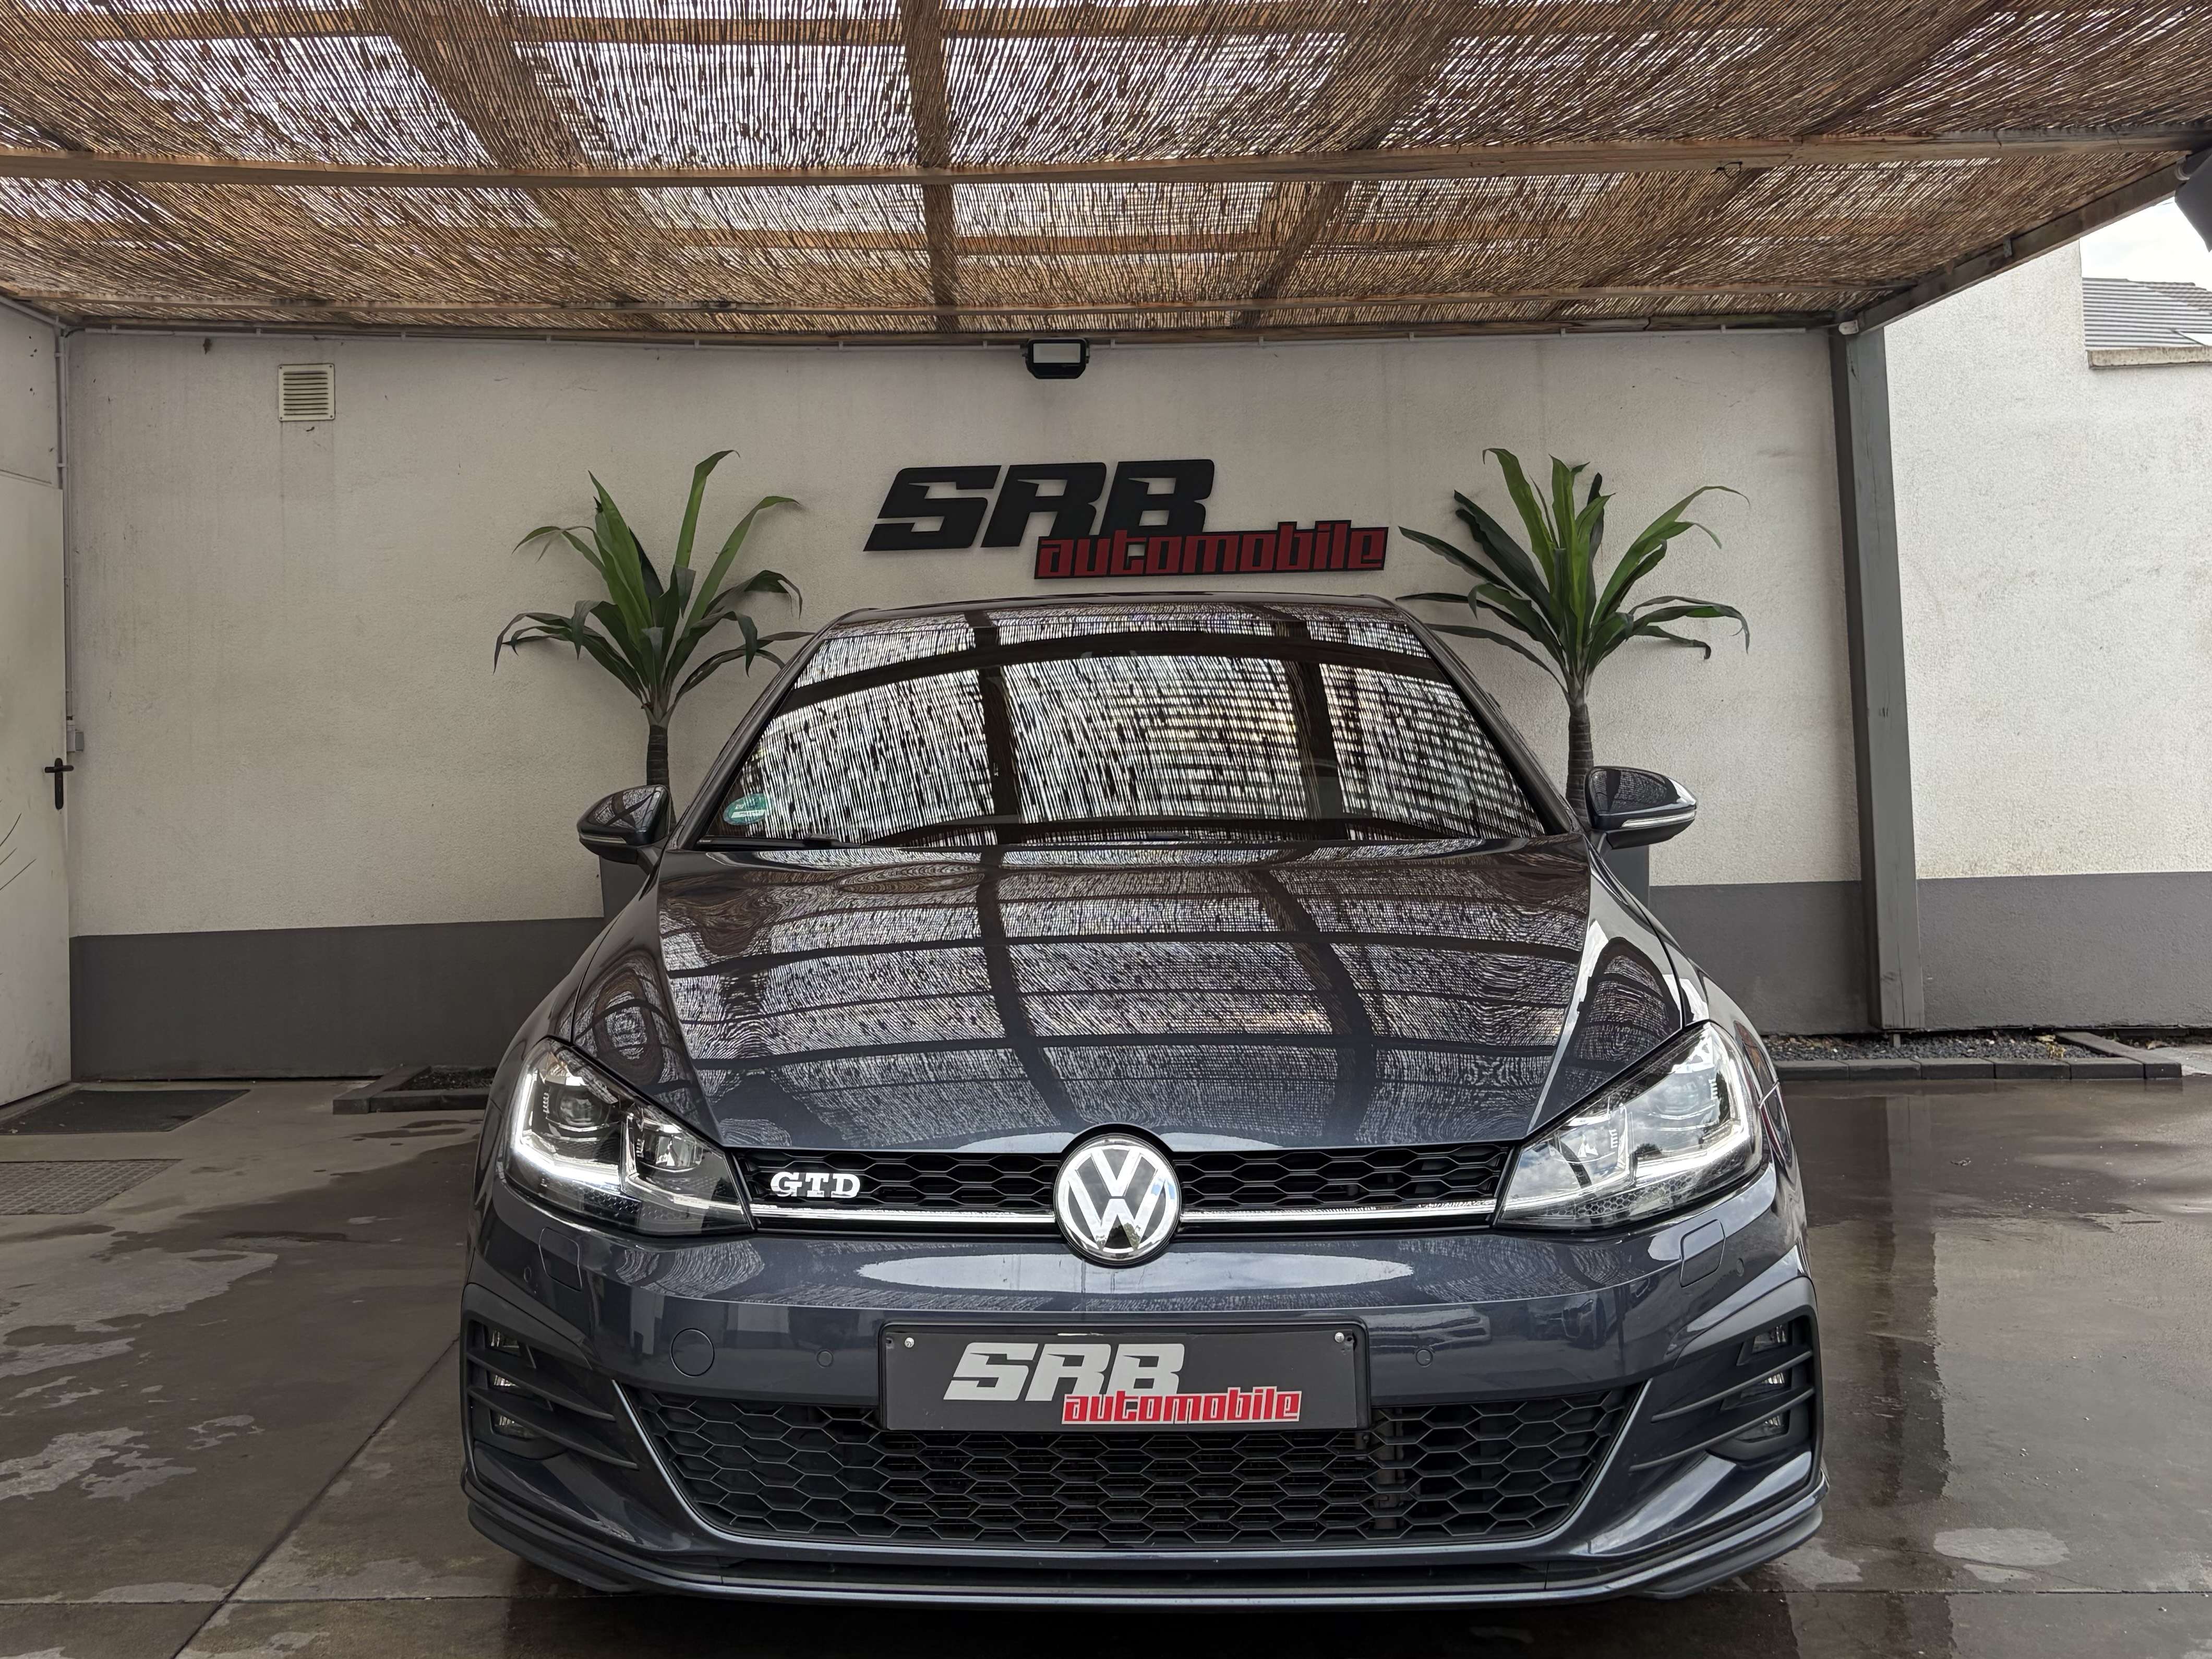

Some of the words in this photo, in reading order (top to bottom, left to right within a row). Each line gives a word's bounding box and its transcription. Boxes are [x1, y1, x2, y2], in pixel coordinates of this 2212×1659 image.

[863, 459, 1215, 551] SRB
[1035, 520, 1389, 579] automobile
[770, 1171, 861, 1198] GTD
[1060, 1143, 1176, 1253] VW
[943, 1342, 1185, 1401] SRB
[1061, 1386, 1302, 1424] automobile
